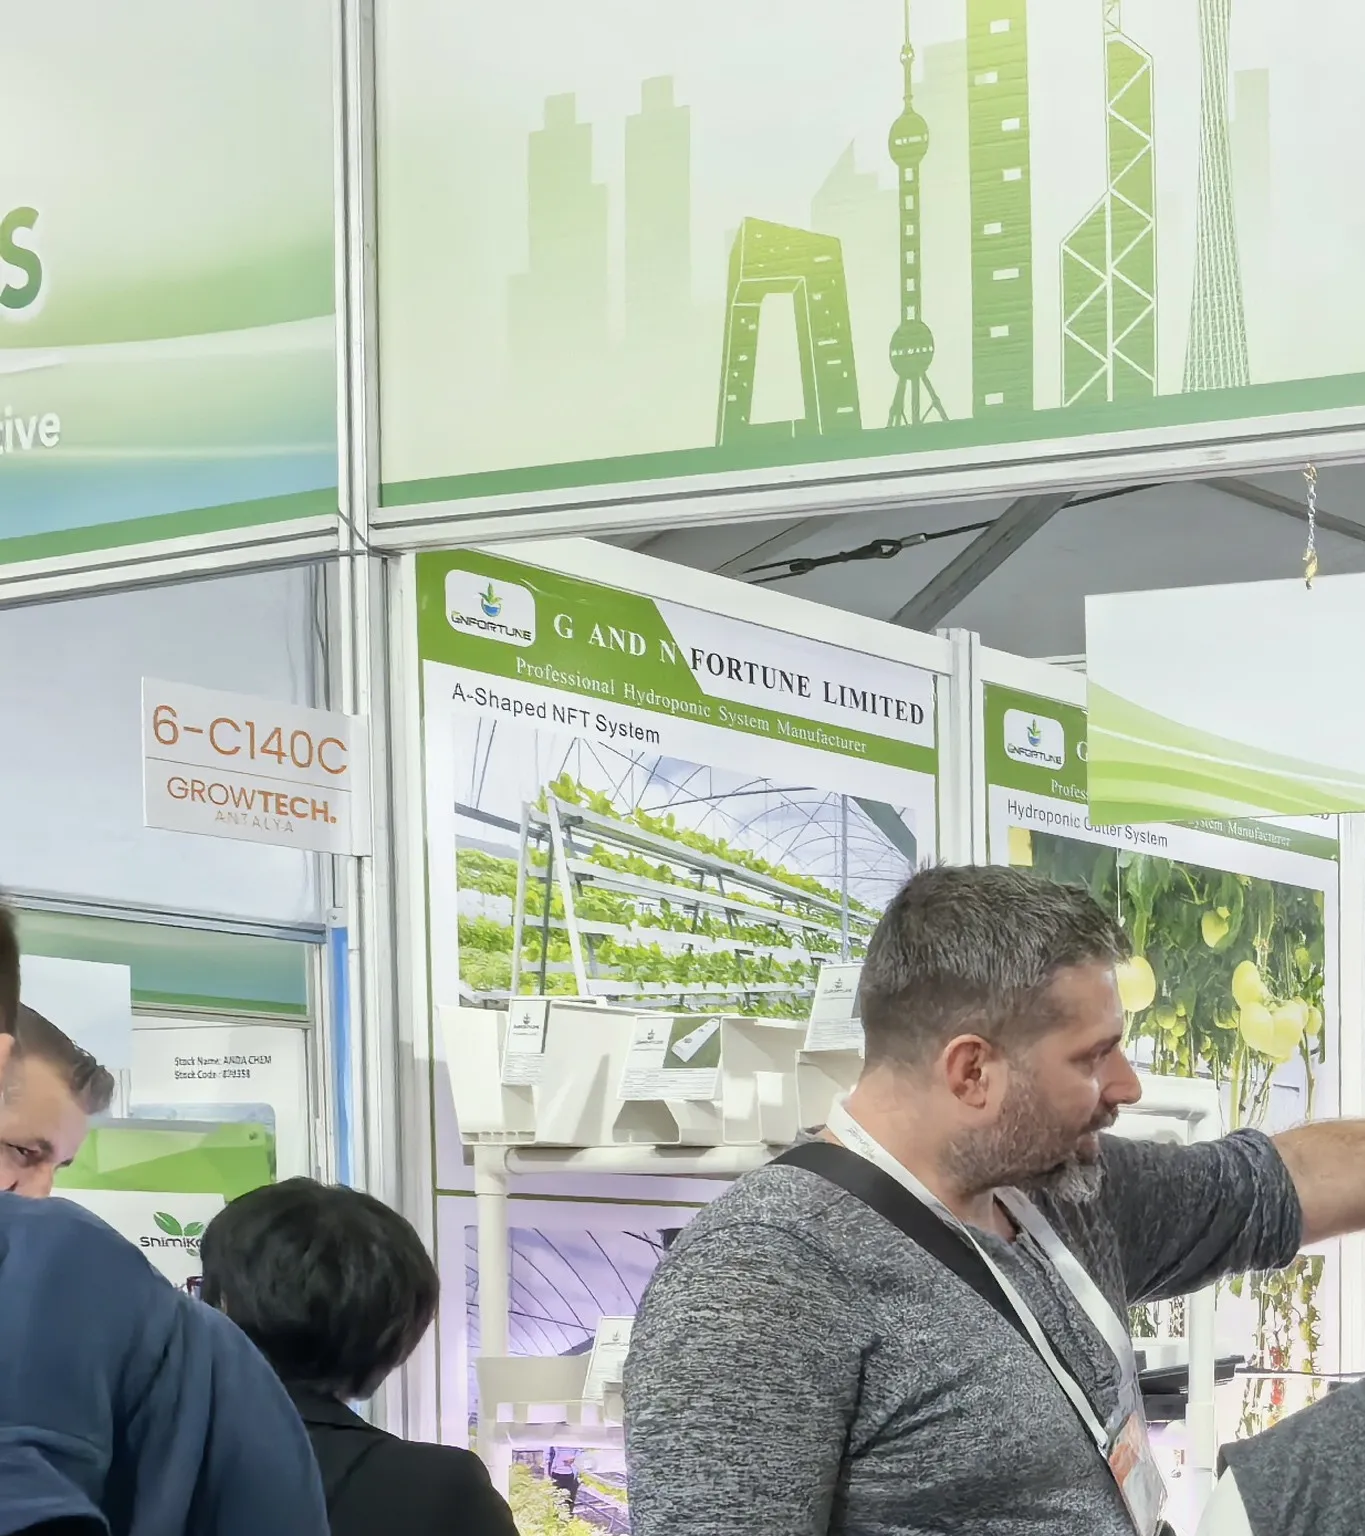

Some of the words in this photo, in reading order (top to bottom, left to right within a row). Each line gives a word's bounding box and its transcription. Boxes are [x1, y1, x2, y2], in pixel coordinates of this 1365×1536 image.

[0, 404, 60, 455] ive
[451, 611, 532, 641] GNFORTUNE
[554, 614, 574, 639] G
[588, 623, 647, 657] AND
[659, 639, 677, 665] N
[690, 647, 811, 698] FORTUNE
[823, 681, 924, 725] LIMITED
[452, 683, 546, 719] A-Shaped
[553, 704, 590, 727] NFT
[595, 714, 660, 744] System
[516, 656, 615, 695] Professional
[624, 682, 711, 718] Hydroponic
[719, 705, 769, 731] System
[777, 719, 867, 753] Manufacturer
[153, 704, 348, 774] 6-C140C
[215, 810, 294, 833] ANTALYA
[1008, 799, 1080, 828] Hydroponic
[1125, 825, 1168, 848] System
